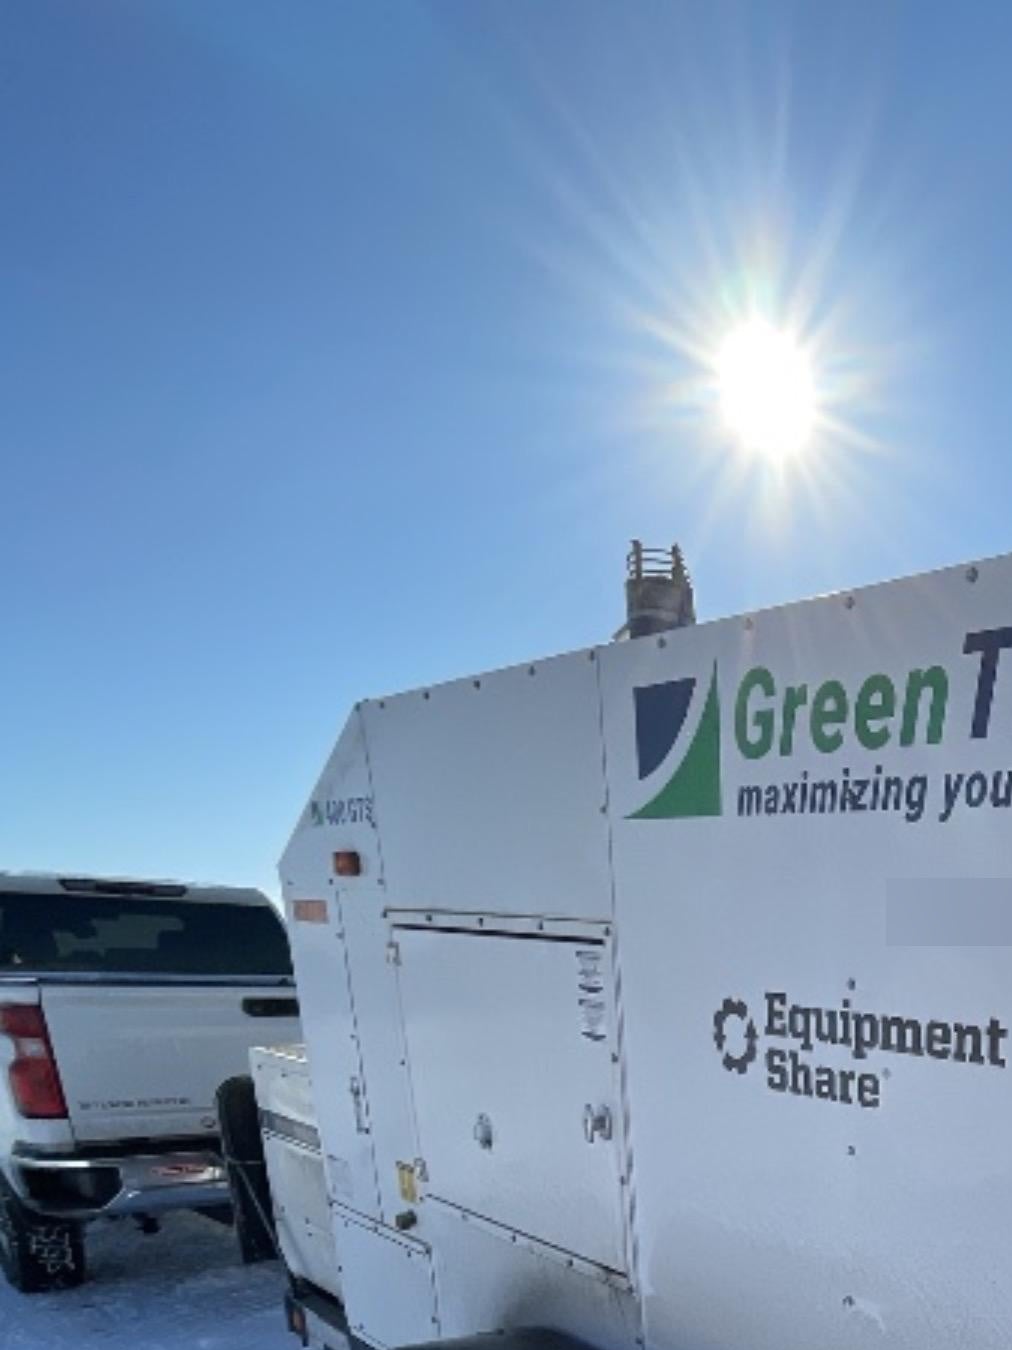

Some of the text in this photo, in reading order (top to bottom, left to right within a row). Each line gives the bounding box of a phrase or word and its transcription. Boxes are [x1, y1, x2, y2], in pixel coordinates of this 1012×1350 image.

[736, 764, 928, 823] maximizing
[764, 992, 1008, 1068] Equipment
[765, 1048, 880, 1107] Share
